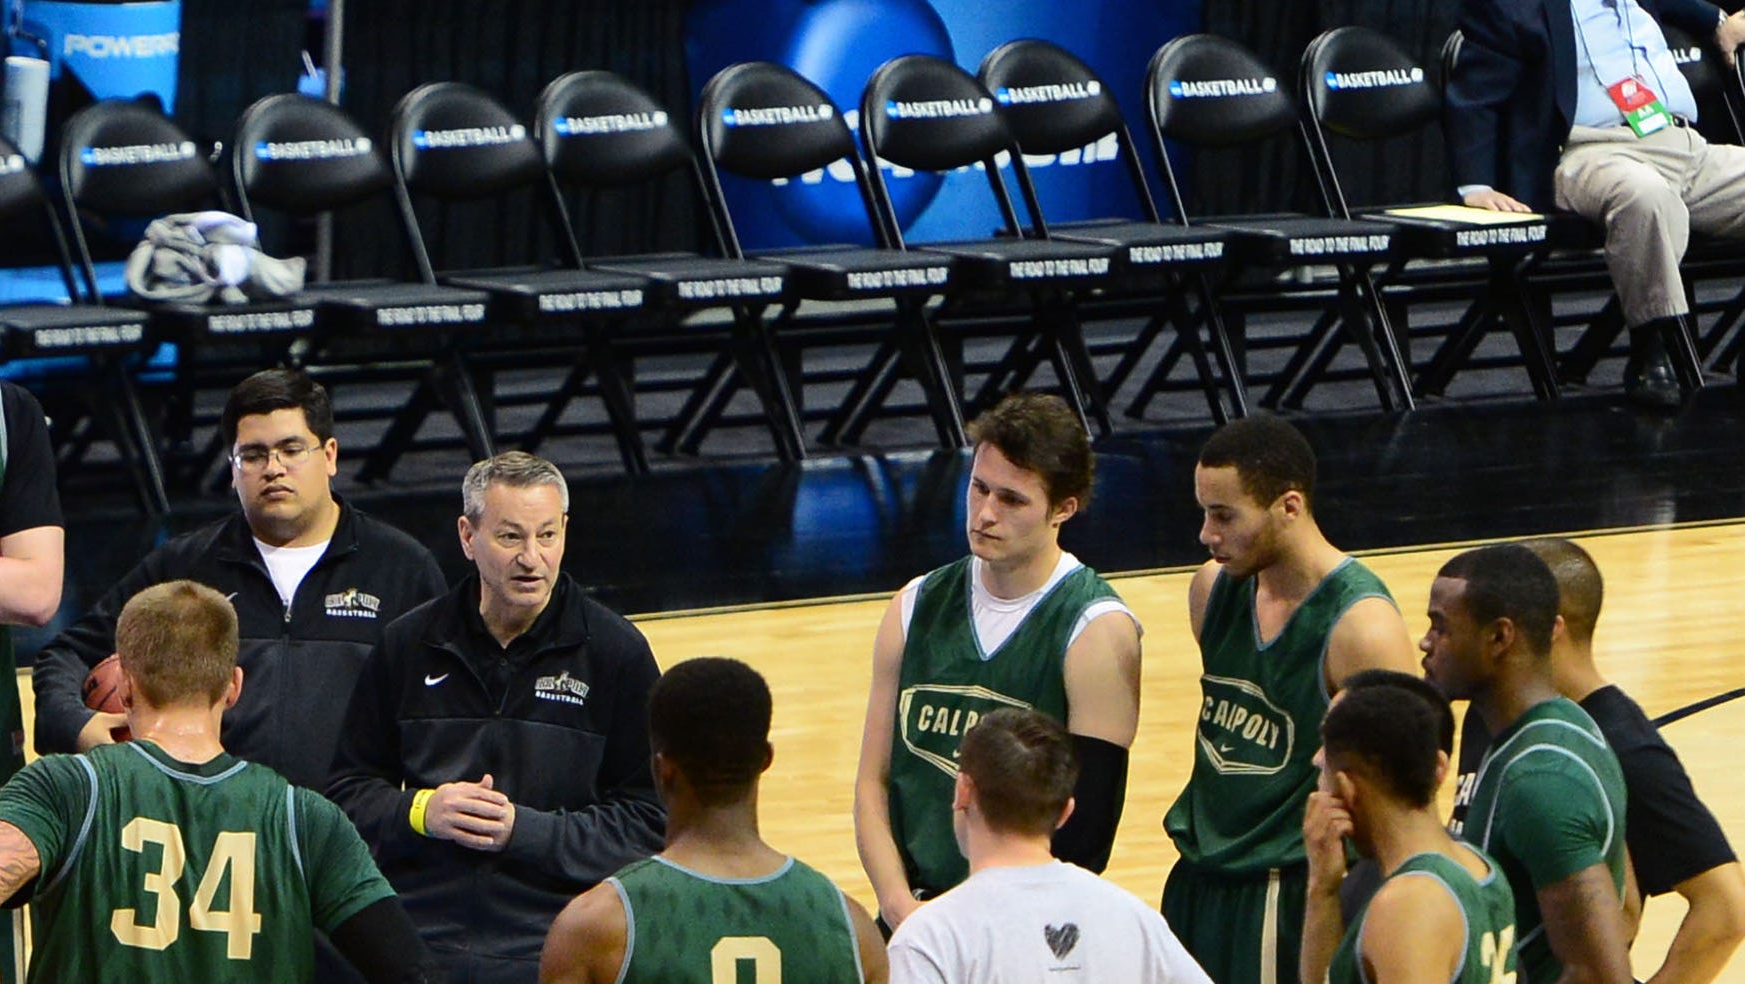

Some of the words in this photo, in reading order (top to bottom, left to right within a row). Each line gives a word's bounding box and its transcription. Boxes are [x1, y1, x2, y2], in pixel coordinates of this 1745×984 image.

[1181, 78, 1263, 97] BASKETBALL
[1336, 69, 1411, 89] BASKETBALL
[1008, 82, 1088, 104] BASKETBALL
[734, 105, 819, 126] BASKETBALL
[896, 99, 980, 118] BASKETBALL
[567, 112, 653, 134] BASKETBALL
[425, 126, 511, 148] BASKETBALL
[93, 143, 182, 165] BASKETBALL
[267, 138, 356, 160] BASKETBALL
[917, 704, 961, 736] CAL
[1230, 706, 1280, 750] POLY
[110, 816, 262, 960] 34
